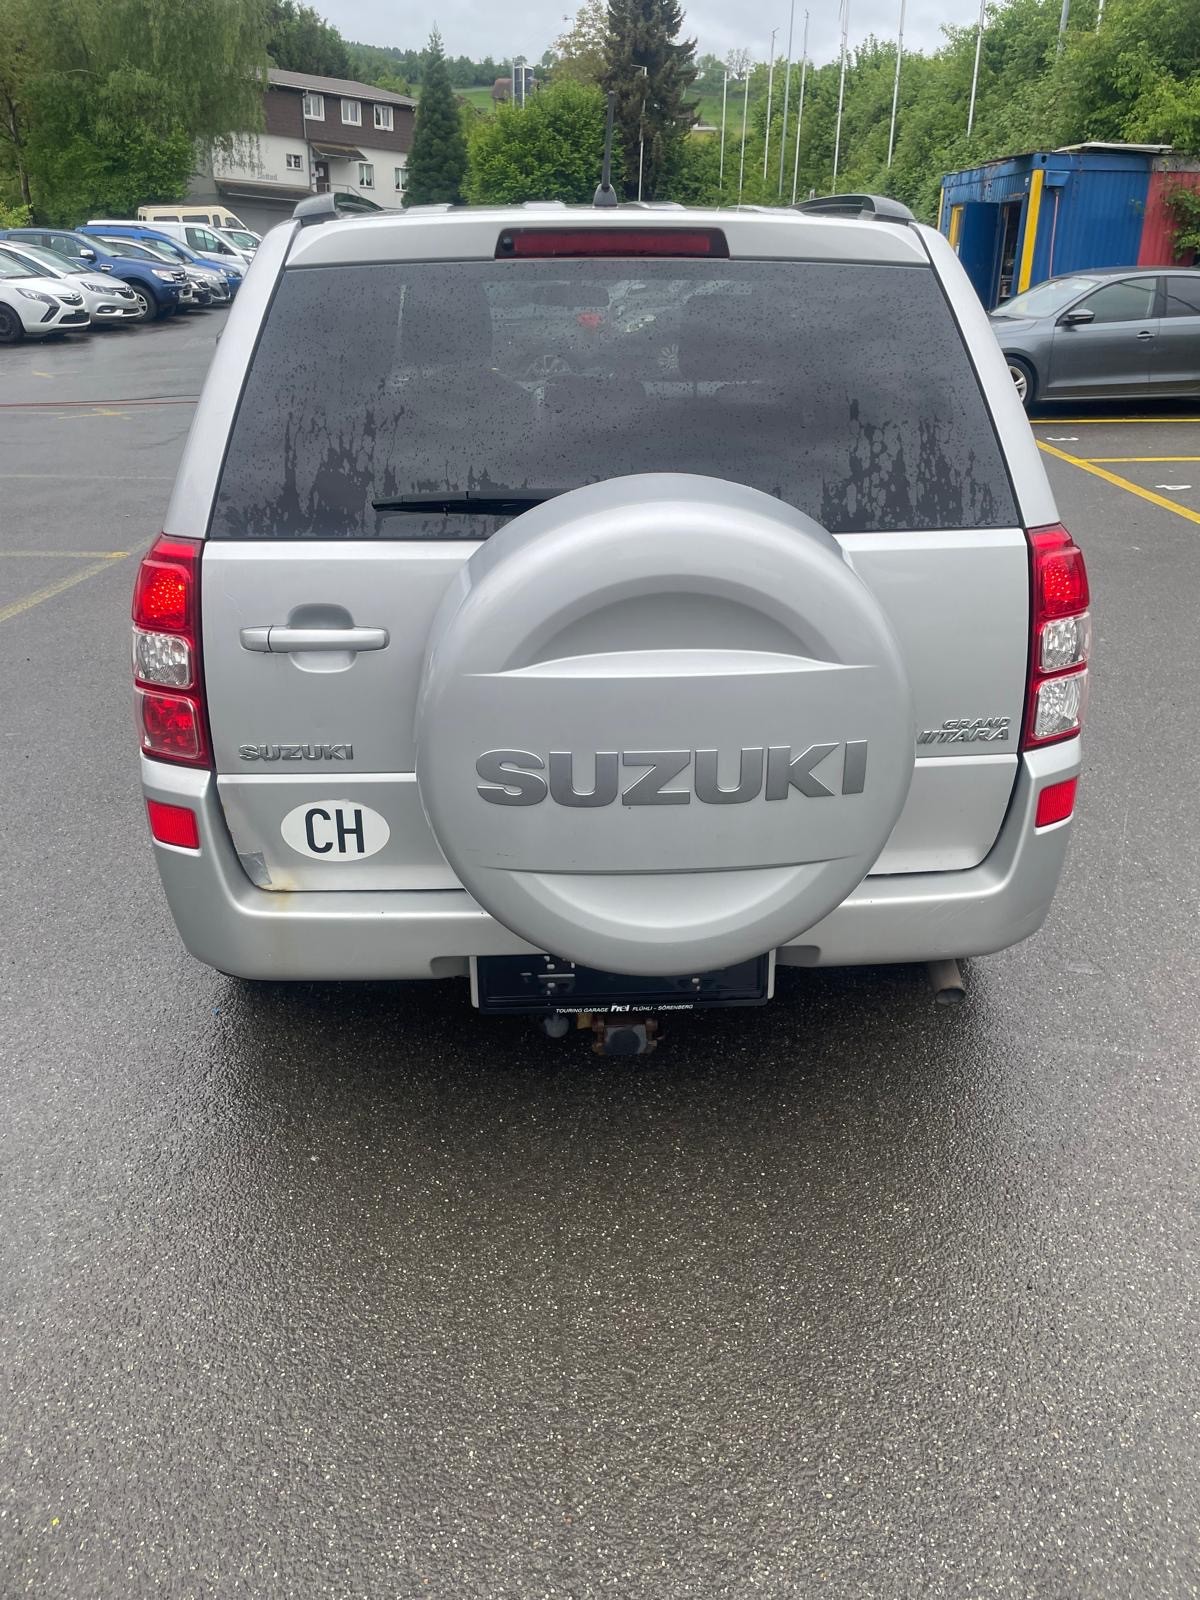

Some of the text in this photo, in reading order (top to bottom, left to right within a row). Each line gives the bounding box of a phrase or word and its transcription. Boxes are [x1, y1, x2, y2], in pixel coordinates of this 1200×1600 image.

[942, 717, 1011, 729] GRAND
[238, 744, 354, 761] SUZUKI
[476, 740, 868, 807] SUZUKI
[304, 807, 366, 854] CH
